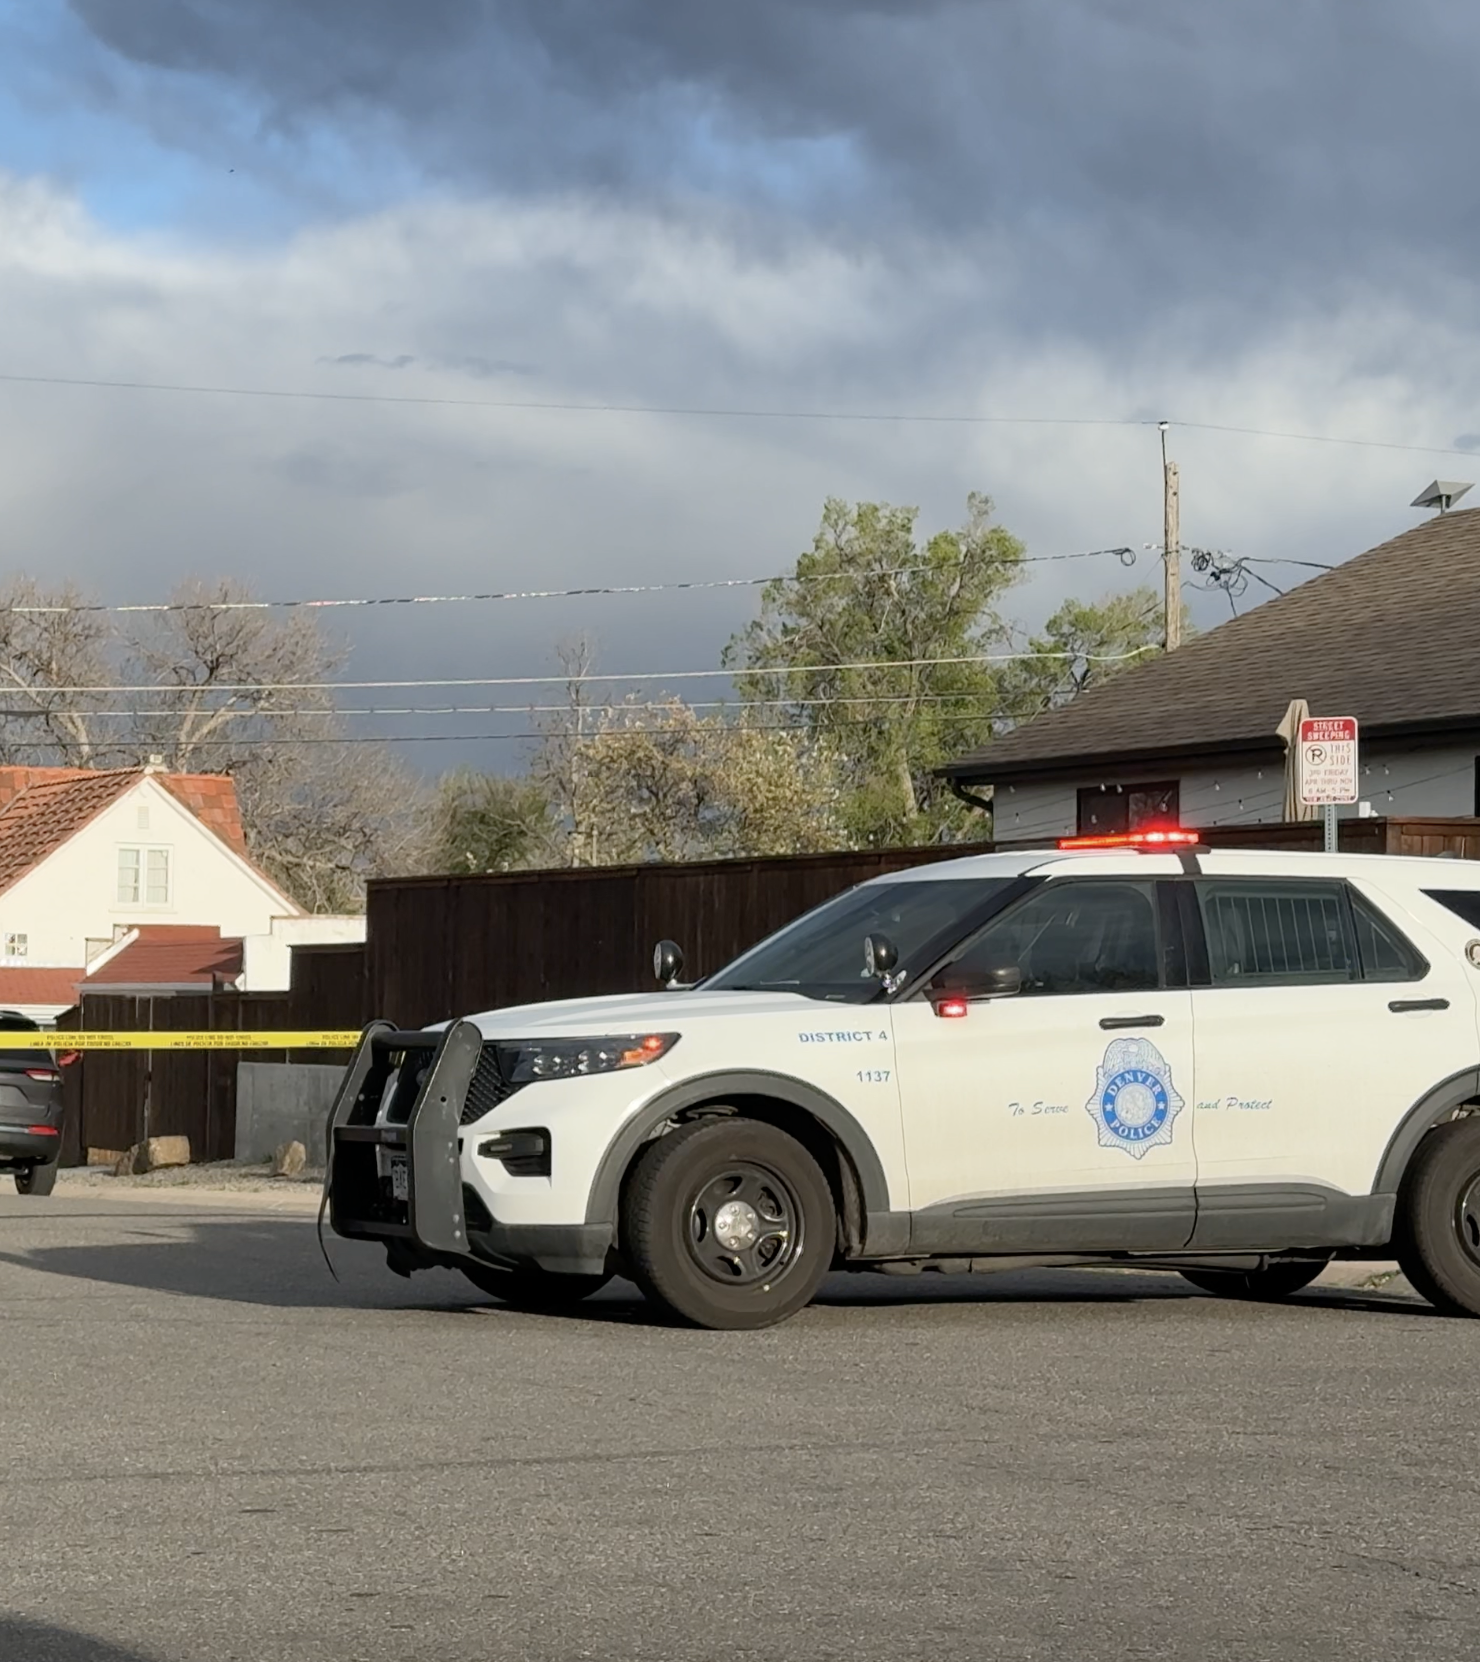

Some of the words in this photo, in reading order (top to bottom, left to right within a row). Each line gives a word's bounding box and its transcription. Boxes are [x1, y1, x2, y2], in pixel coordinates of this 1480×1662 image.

[1313, 721, 1344, 731] STREET
[1308, 730, 1350, 740] SWEEPING
[1330, 744, 1351, 754] THIS
[1330, 755, 1351, 766] SIDE
[798, 1031, 872, 1043] DISTRICT
[878, 1030, 888, 1040] 4
[856, 1070, 891, 1082] 1137
[1108, 1070, 1162, 1098] DENVER
[1008, 1102, 1025, 1117] To
[1030, 1101, 1070, 1115] Serve
[1196, 1098, 1221, 1110] and
[1225, 1097, 1273, 1111] Protect
[1110, 1116, 1162, 1140] POLICE
